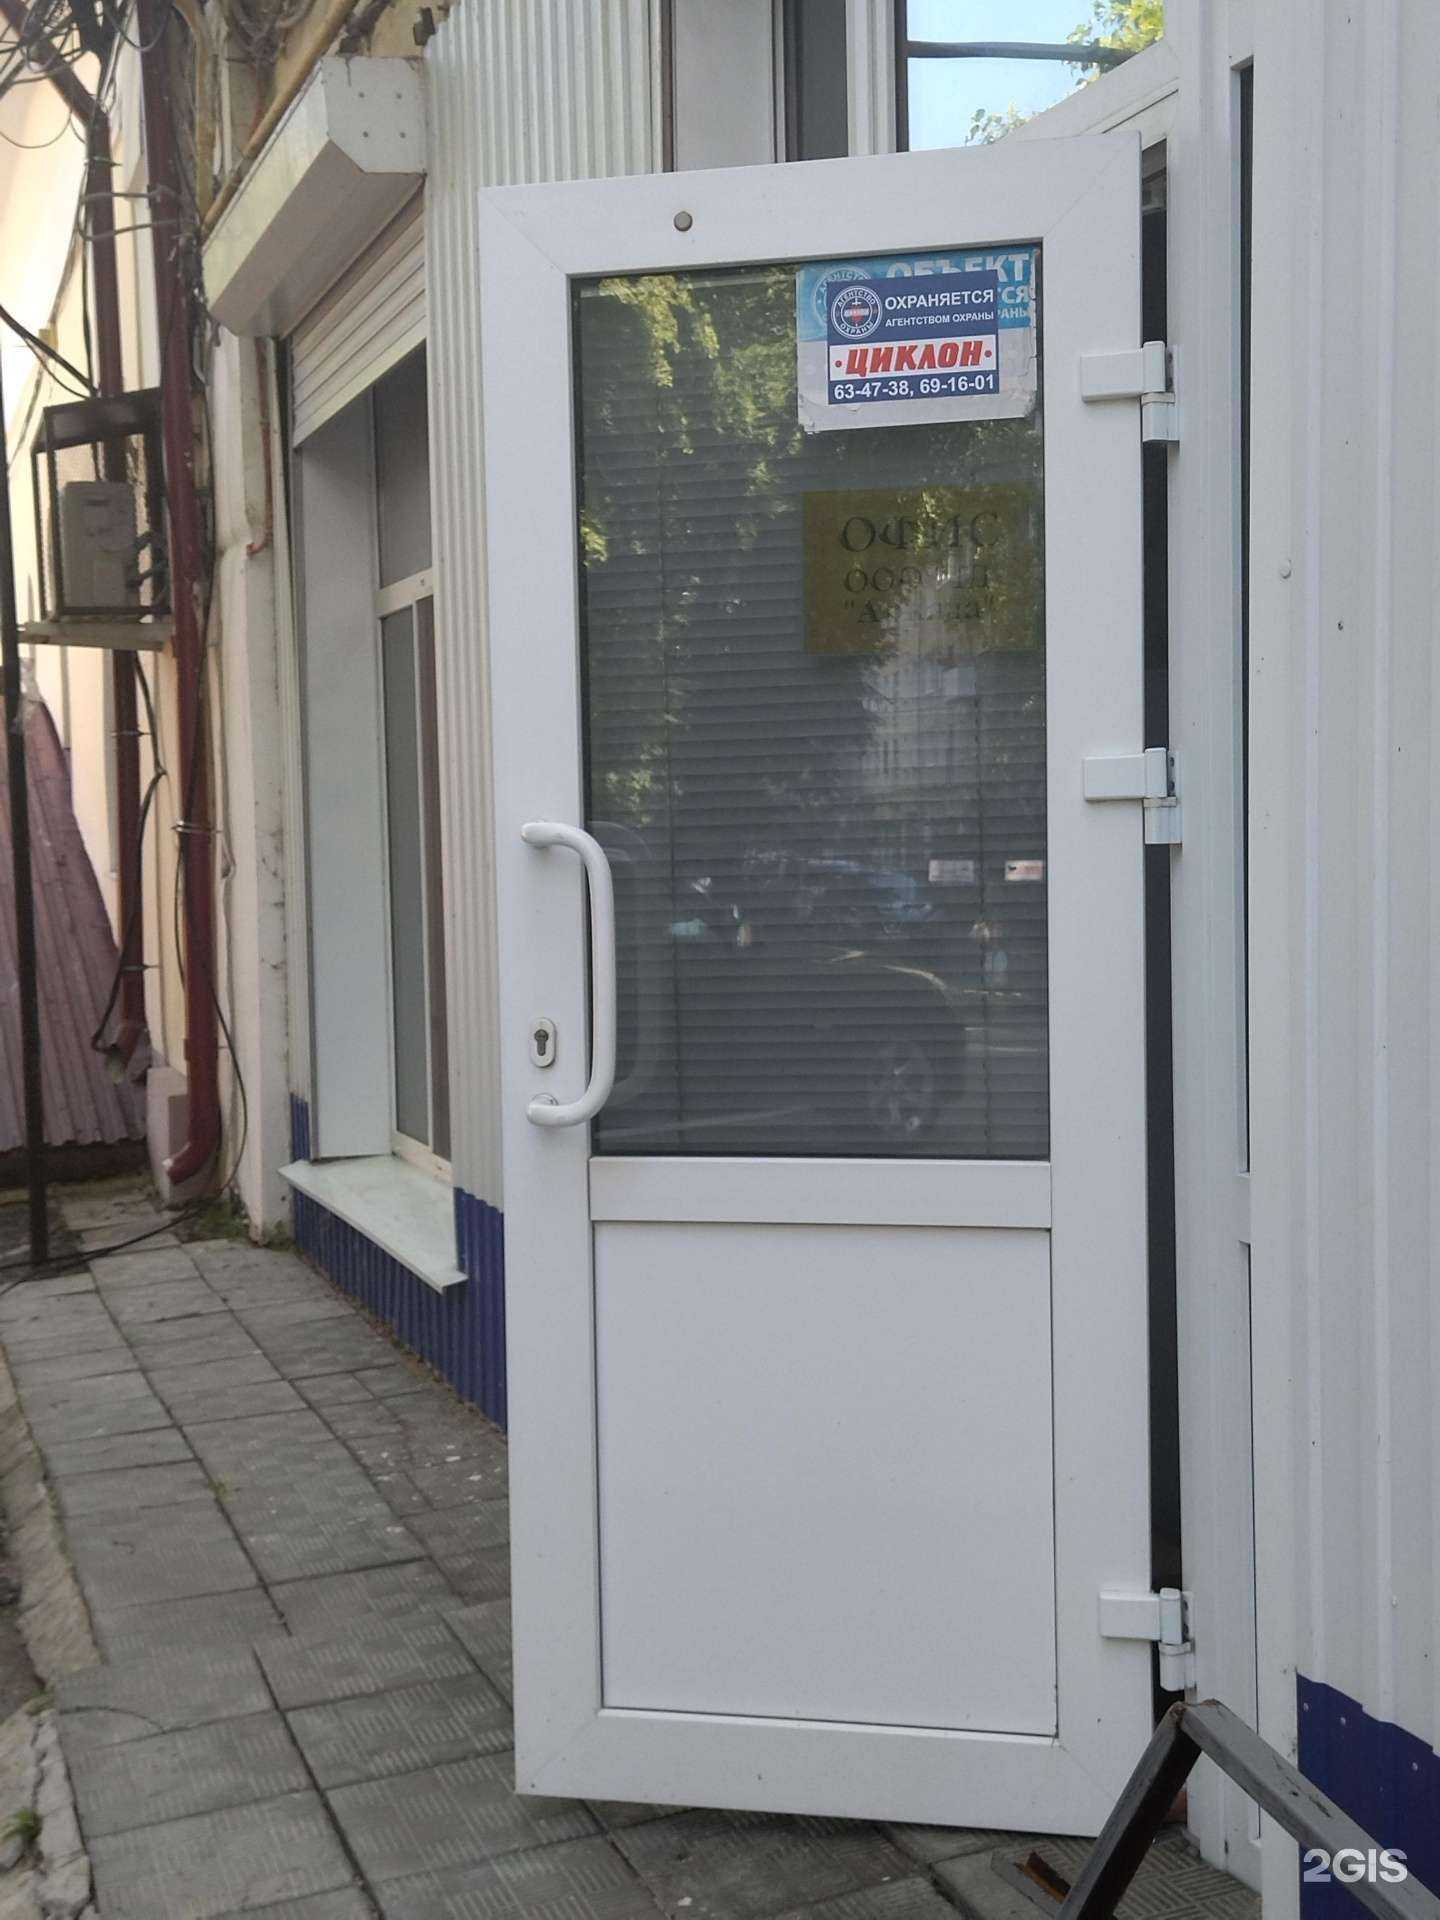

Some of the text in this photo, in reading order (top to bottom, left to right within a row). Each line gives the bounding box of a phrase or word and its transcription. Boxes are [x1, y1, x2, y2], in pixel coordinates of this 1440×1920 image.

[884, 289, 994, 310] ОХРАНЯЕТСЯ
[840, 320, 874, 334] ОХРАНЫ
[885, 311, 994, 328] АГЕНТСТВОМ ОХРАНЫ
[833, 374, 994, 400] 63-47-38, 69-16-01
